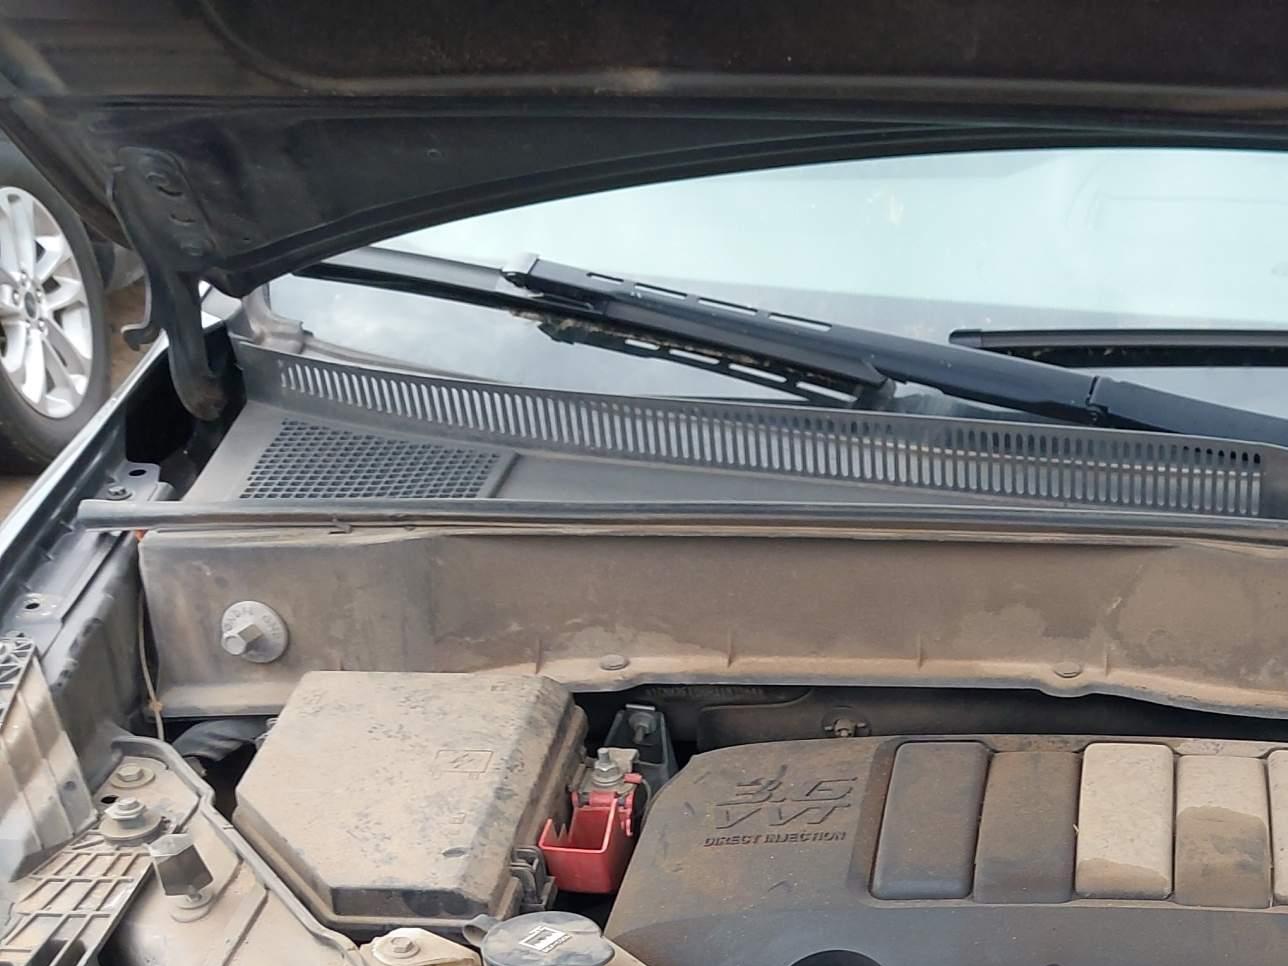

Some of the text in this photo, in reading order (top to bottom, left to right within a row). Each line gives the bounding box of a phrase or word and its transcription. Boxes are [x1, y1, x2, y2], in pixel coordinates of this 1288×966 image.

[716, 776, 858, 807] 3.6
[715, 803, 851, 830] VVT
[703, 831, 847, 848] DIRECT INJECTION
